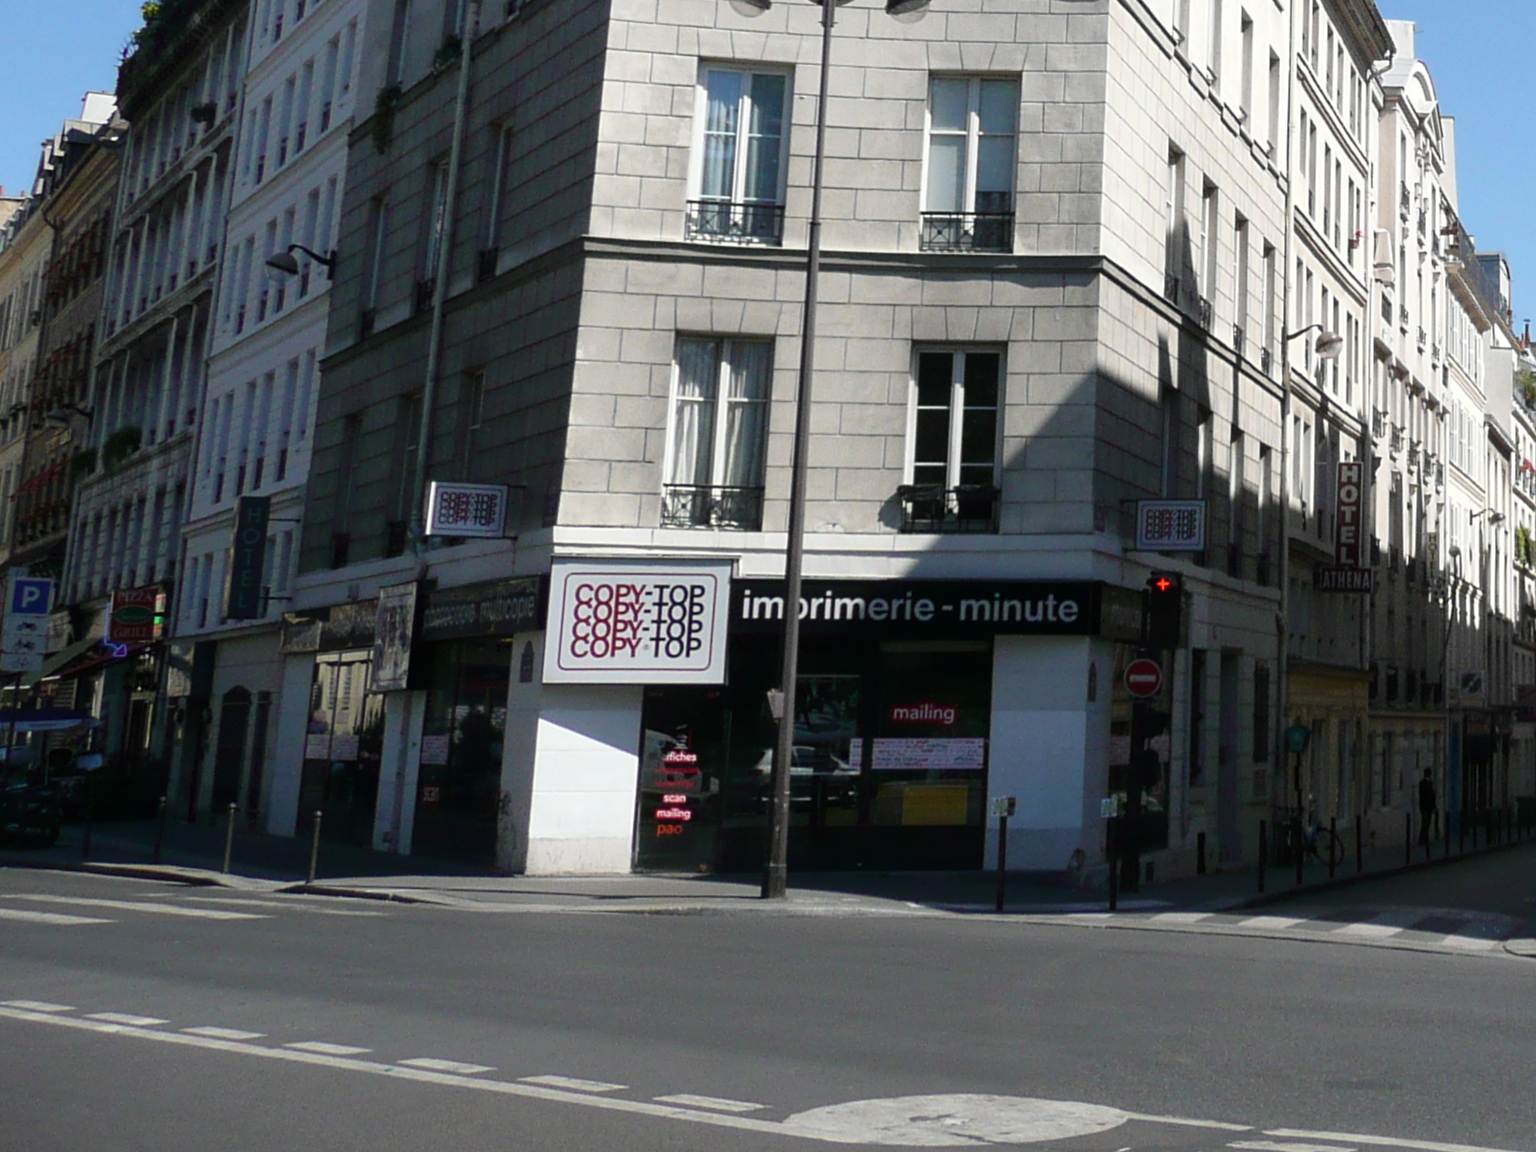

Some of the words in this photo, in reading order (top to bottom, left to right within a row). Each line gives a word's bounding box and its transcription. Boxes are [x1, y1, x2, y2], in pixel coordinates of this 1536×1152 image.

[440, 491, 498, 501] COPY-TOP
[1146, 508, 1197, 517] COPY-TOP
[1340, 464, 1359, 565] HOTEL
[238, 508, 261, 608] HOTEL
[21, 585, 42, 609] P
[116, 589, 153, 603] PIZZA
[575, 584, 706, 604] COPY-TOP
[480, 595, 536, 625] multicopie
[573, 602, 705, 622] COPY-TOP
[741, 589, 936, 622] imrimerie
[958, 592, 1079, 623] minute
[113, 625, 148, 639] GRILL
[572, 619, 704, 640] COPY-TOP
[893, 703, 955, 725] mailing
[663, 794, 687, 803] scan
[656, 808, 692, 821] mailing
[656, 823, 683, 837] pao
